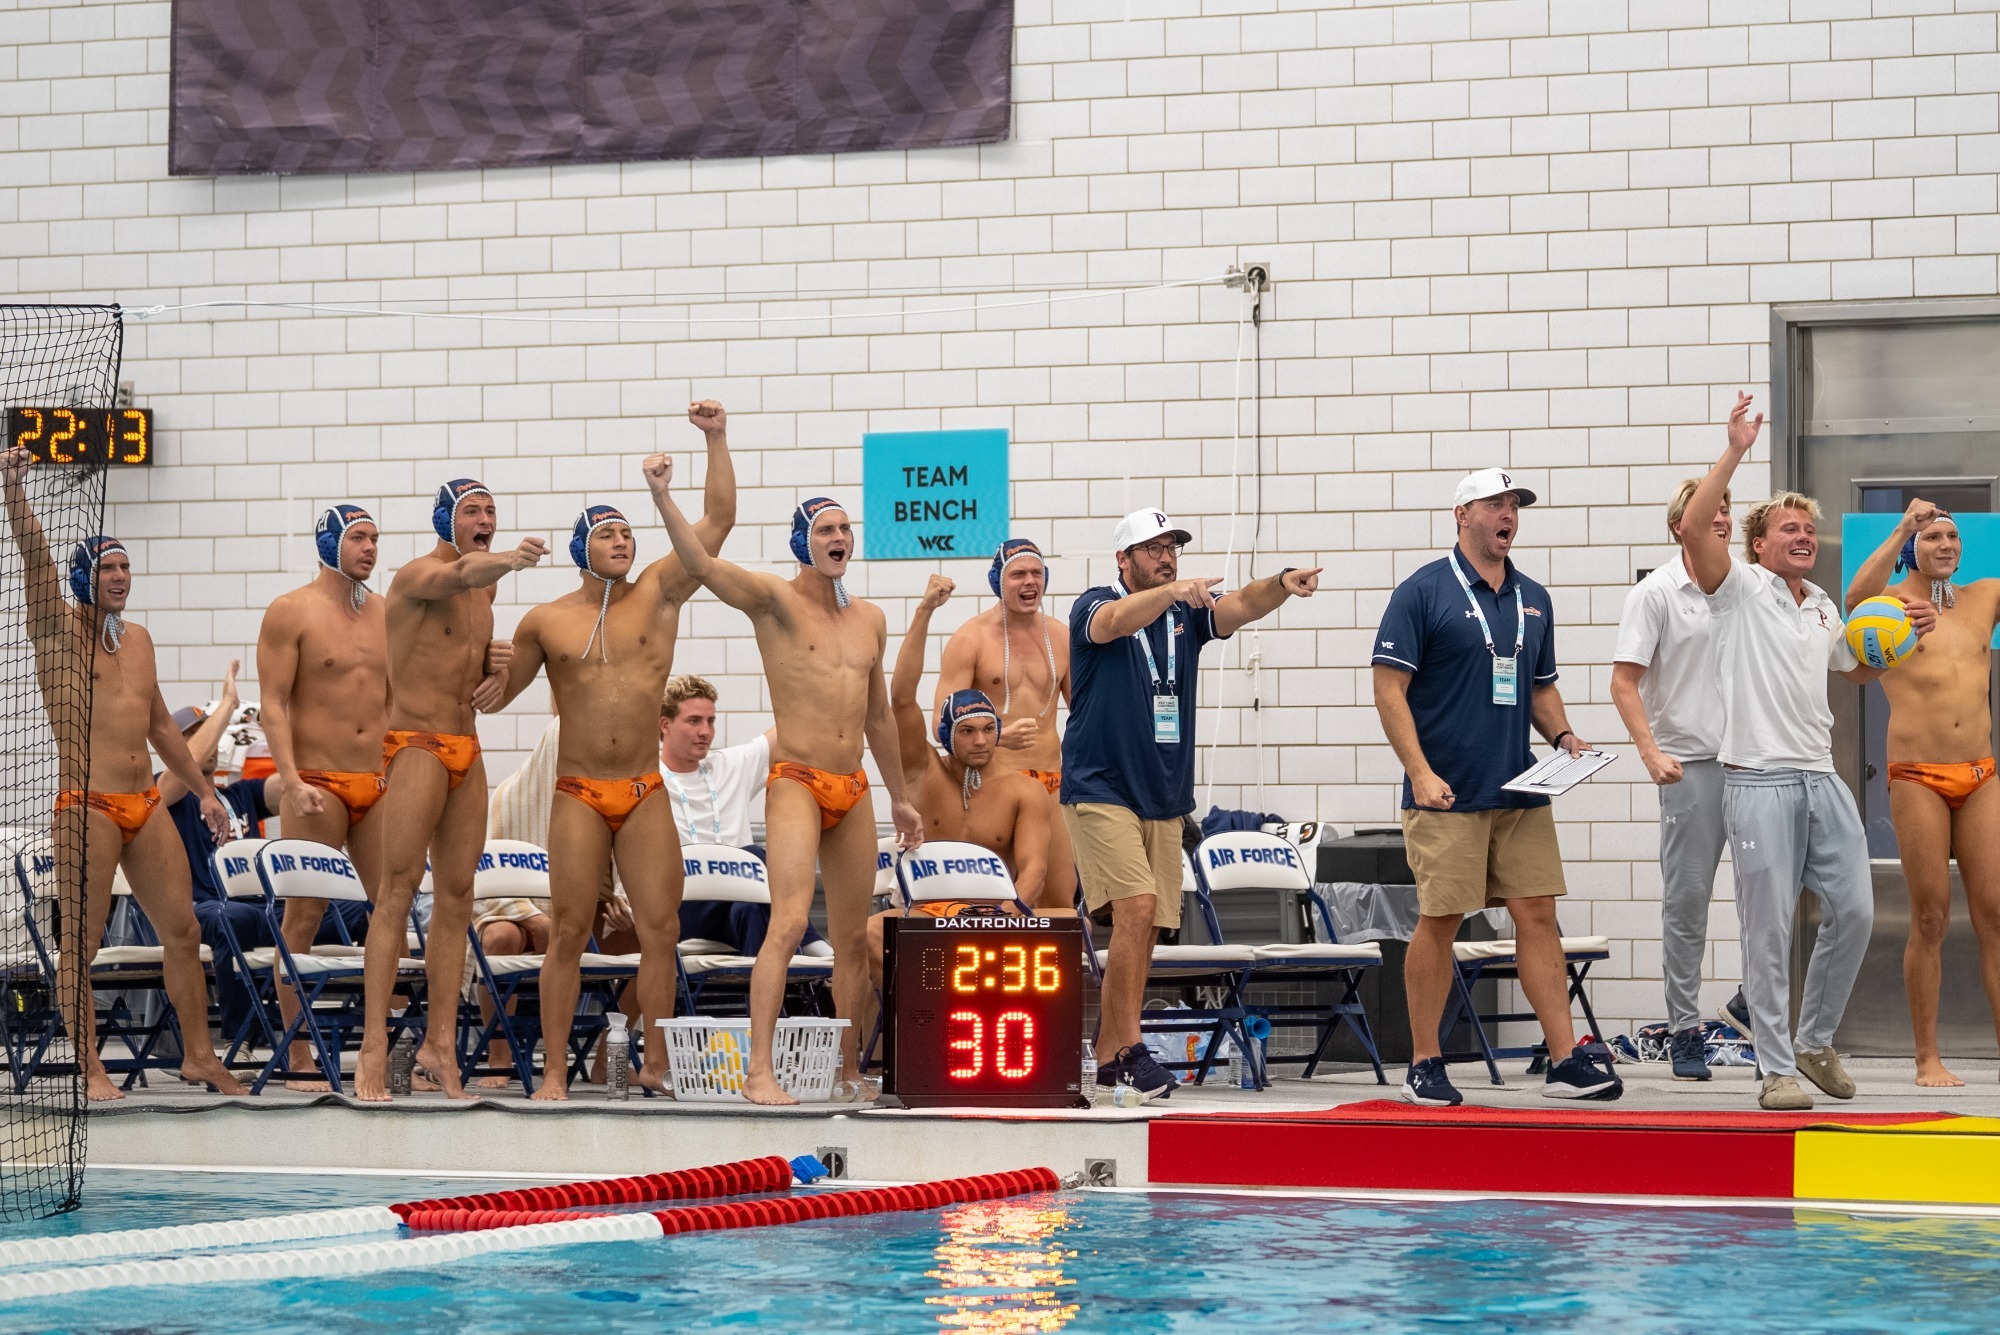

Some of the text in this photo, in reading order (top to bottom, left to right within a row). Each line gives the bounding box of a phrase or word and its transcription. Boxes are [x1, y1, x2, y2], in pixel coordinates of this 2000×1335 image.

[18, 409, 147, 462] 22:13
[902, 465, 968, 487] TEAM
[1499, 473, 1511, 488] P
[895, 499, 977, 522] BENCH
[1152, 513, 1166, 527] P
[918, 535, 955, 551] WCC
[631, 781, 648, 799] P
[223, 857, 250, 878] AIR
[270, 853, 357, 880] AIR FORCE
[498, 853, 549, 873] FORCE
[877, 852, 893, 870] IR
[1208, 847, 1298, 870] AIR FORCE
[683, 859, 765, 883] IR FORCE
[909, 858, 1004, 882] AIR FORCE
[935, 917, 1051, 928] DAKTRONICS
[954, 946, 1059, 992] 2:36
[950, 1011, 1033, 1078] 30
